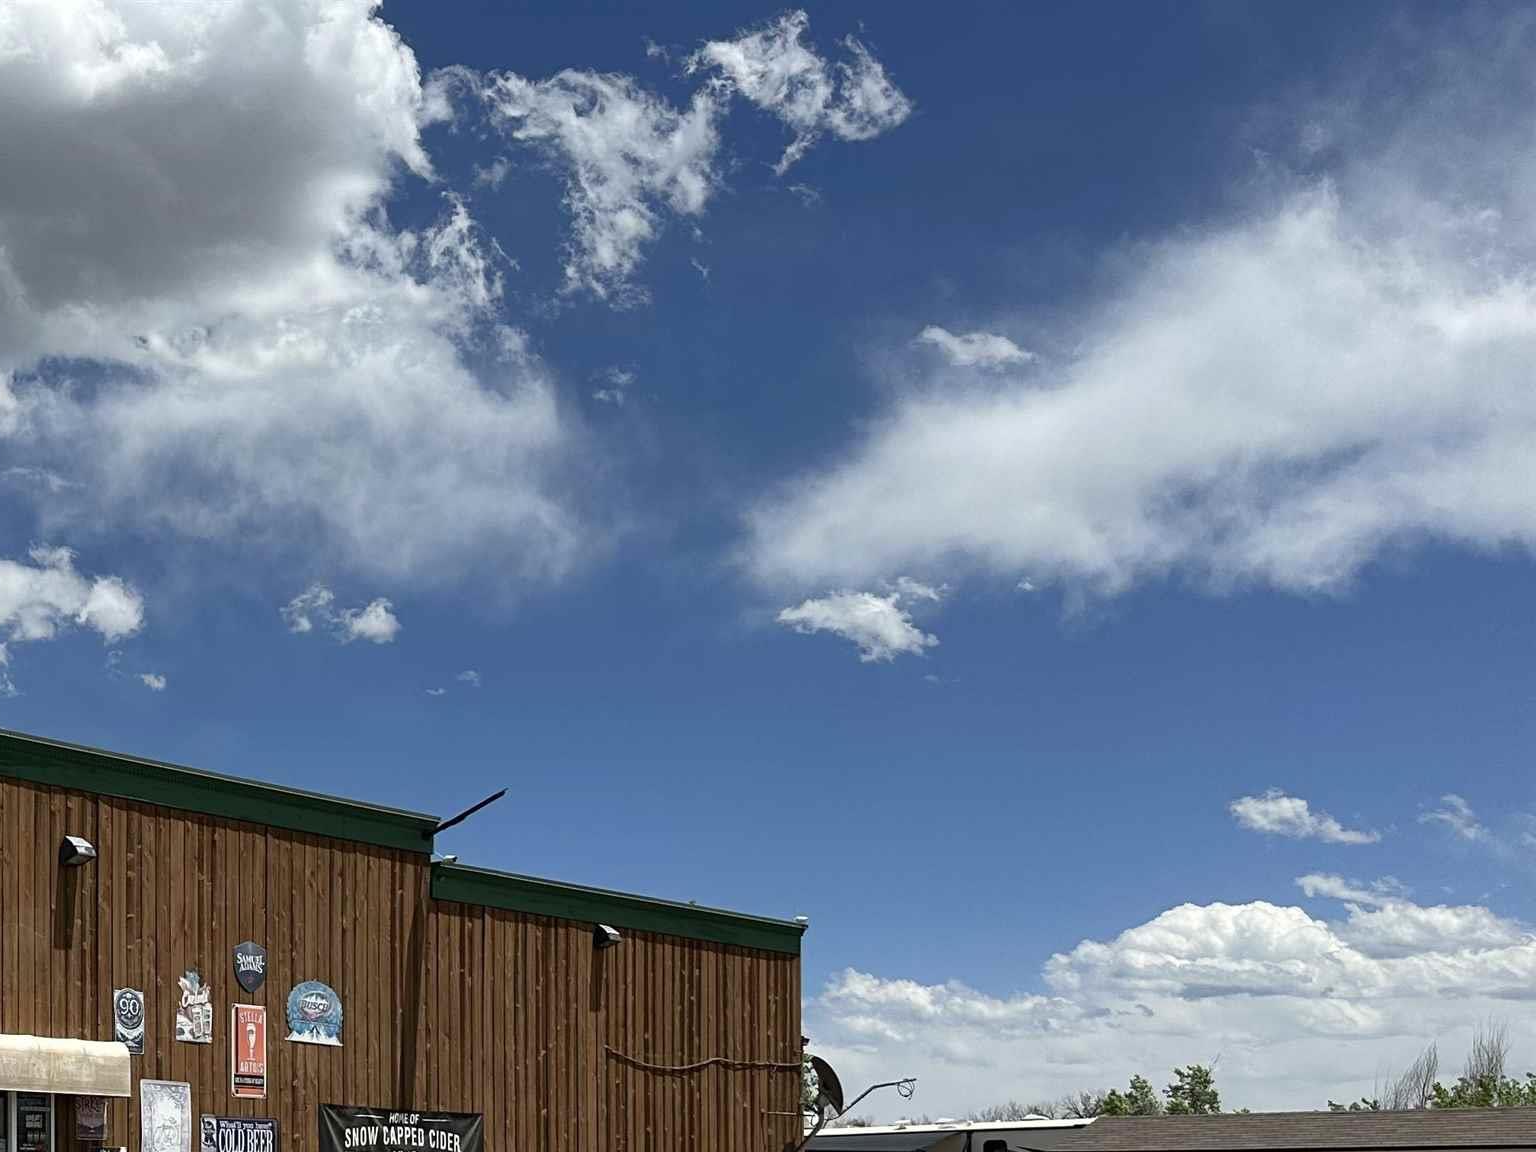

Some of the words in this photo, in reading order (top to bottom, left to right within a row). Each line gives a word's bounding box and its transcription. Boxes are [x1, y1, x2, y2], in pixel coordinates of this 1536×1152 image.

[236, 952, 265, 966] SAMUEL
[239, 963, 263, 974] ADAMS
[118, 998, 140, 1015] 90
[300, 998, 328, 1012] BUSCH
[239, 1010, 263, 1024] STELLA
[239, 1060, 264, 1074] ARTOIS
[389, 1112, 409, 1124] HOME
[409, 1113, 419, 1125] OF
[345, 1126, 379, 1148] SNOW
[382, 1126, 424, 1147] CAPPED
[428, 1129, 461, 1152] CIDER
